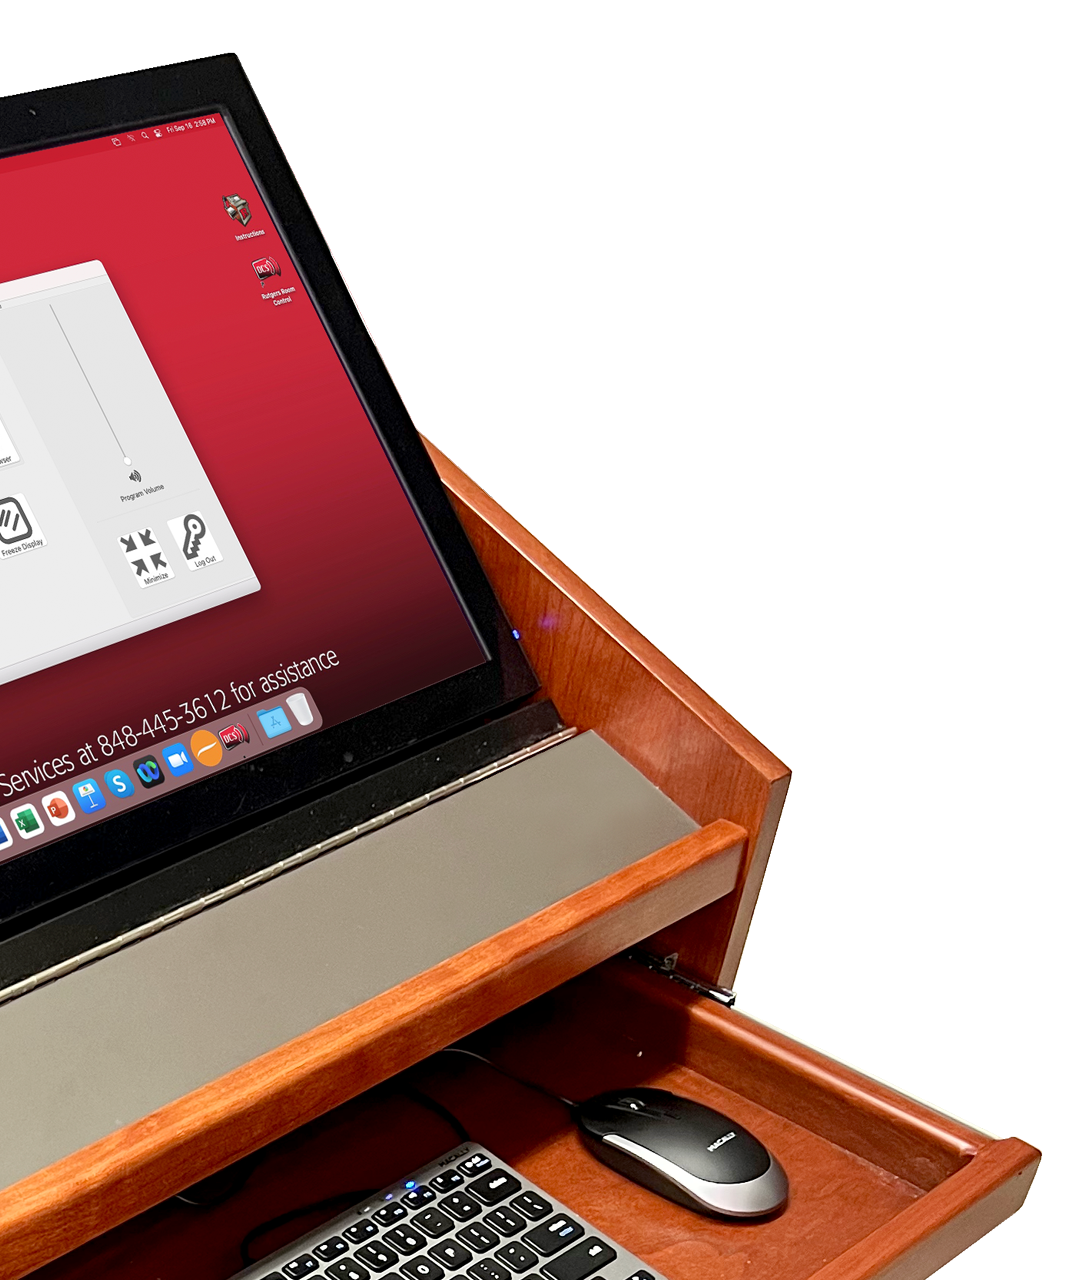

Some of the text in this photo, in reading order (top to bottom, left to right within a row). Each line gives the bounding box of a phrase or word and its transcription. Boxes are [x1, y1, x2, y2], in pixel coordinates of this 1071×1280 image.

[206, 117, 216, 125] PM
[234, 229, 265, 241] Instructions
[256, 264, 270, 274] DCS
[261, 286, 296, 300] Rutgers Room
[273, 296, 292, 306] Control
[120, 483, 165, 503] Program Volume
[1, 537, 44, 557] Freeze Display
[194, 555, 217, 569] Log Out
[144, 571, 169, 585] Minimize
[77, 743, 99, 766] at
[97, 688, 232, 758] 848-445-3612
[229, 681, 258, 705] for
[258, 649, 340, 694] assistance
[223, 732, 238, 744] DCS
[112, 774, 127, 793] S
[50, 806, 57, 815] P
